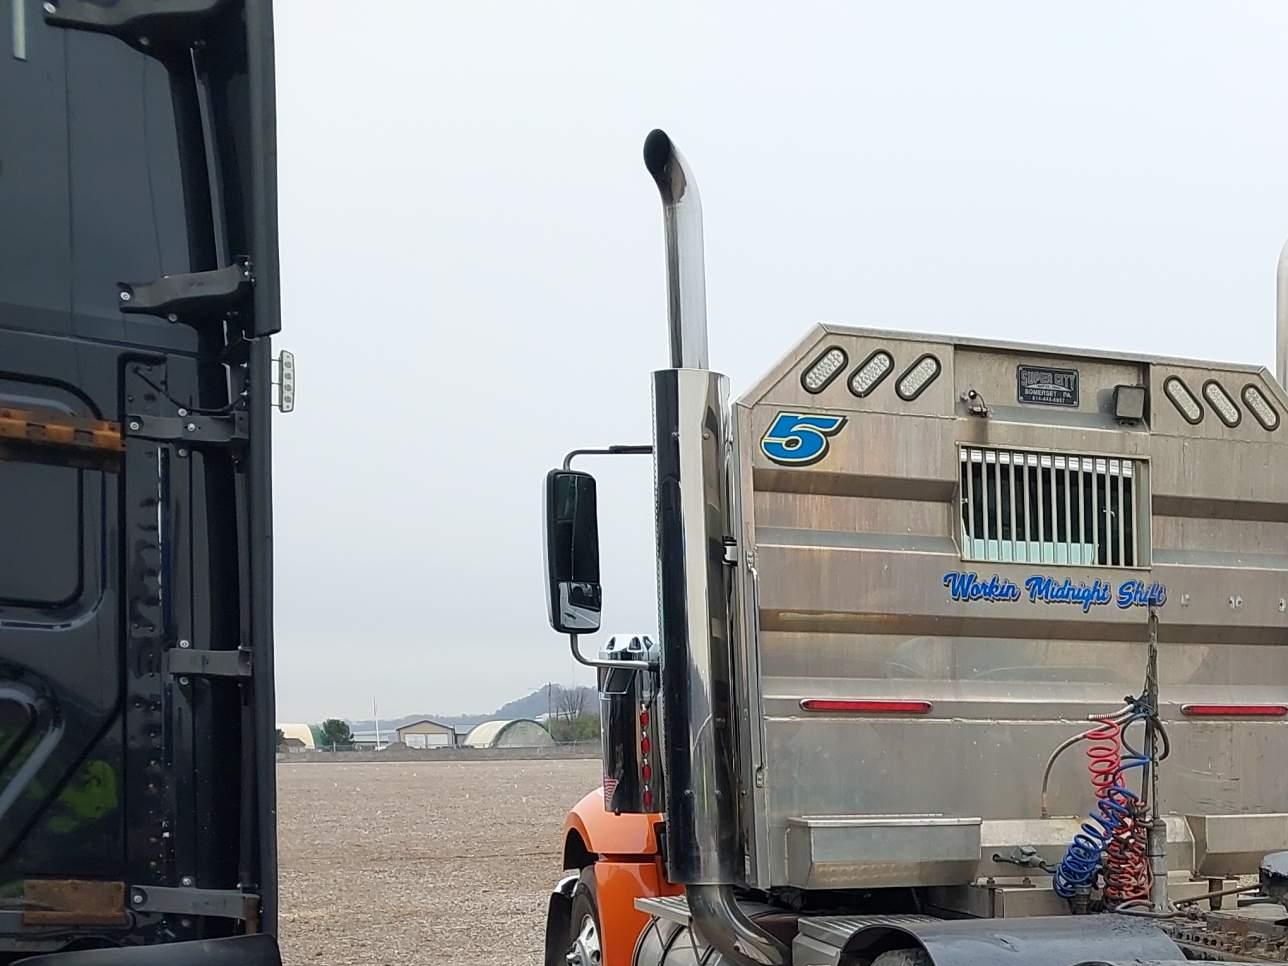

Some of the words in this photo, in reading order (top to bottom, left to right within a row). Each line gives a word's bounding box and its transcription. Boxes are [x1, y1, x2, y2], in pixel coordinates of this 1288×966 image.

[1021, 370, 1053, 386] SUPER
[1054, 373, 1075, 391] CITY
[760, 411, 849, 467] 5
[943, 571, 1021, 602] Workin
[1025, 575, 1112, 613] Midnight
